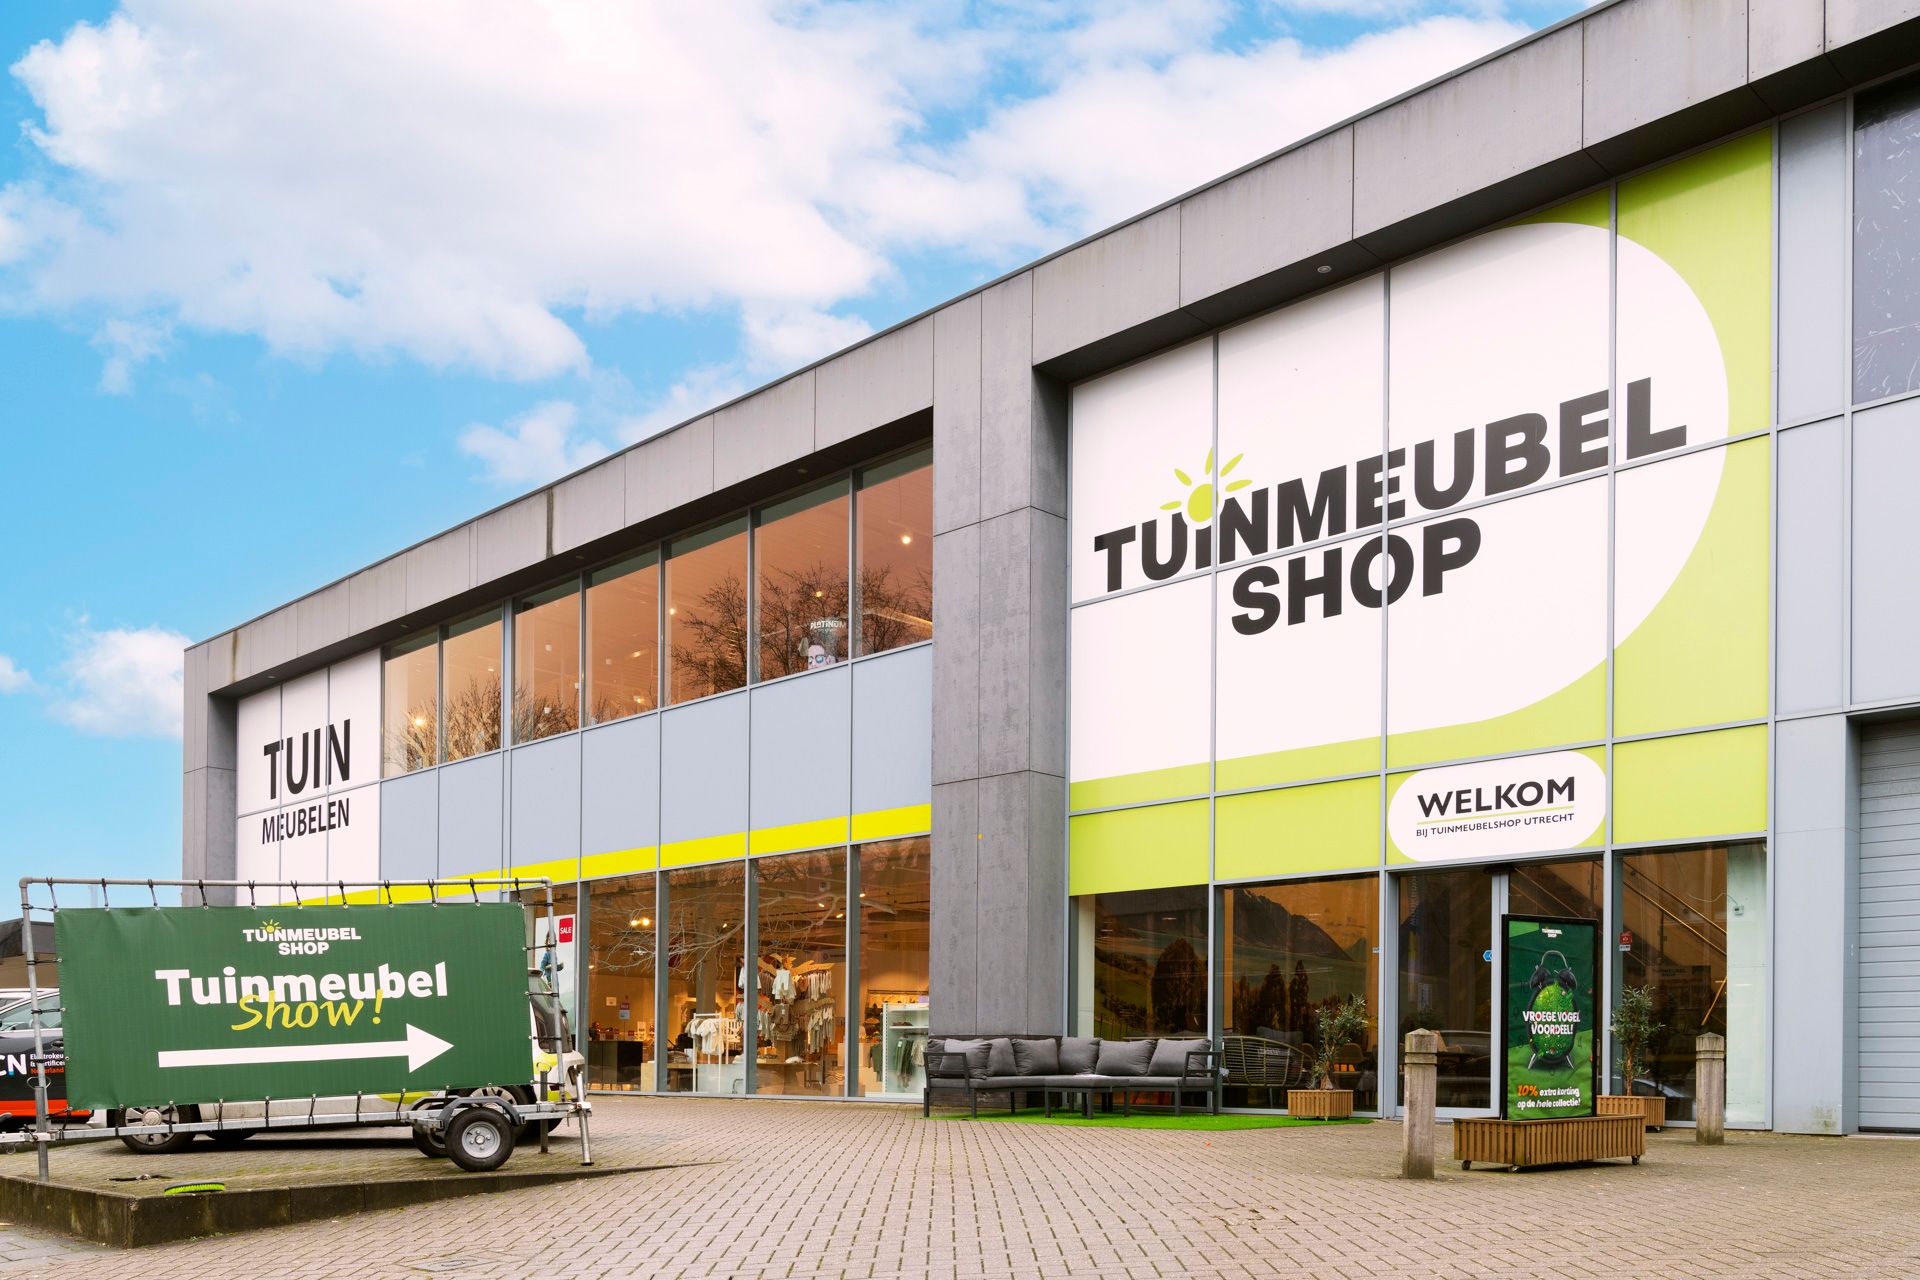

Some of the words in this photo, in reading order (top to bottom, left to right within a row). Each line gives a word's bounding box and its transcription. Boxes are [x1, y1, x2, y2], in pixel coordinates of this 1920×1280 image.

[1231, 516, 1482, 637] SHOP
[263, 719, 350, 800] TUIN
[1417, 776, 1575, 818] WELKOM
[262, 798, 349, 844] MEUBELEN
[1416, 828, 1429, 838] BIJ
[1431, 819, 1522, 836] TUINMEUBELSHOP
[1524, 813, 1575, 826] UTRECHT
[559, 926, 573, 935] SALE
[278, 941, 330, 956] SHOP
[154, 960, 449, 1006] Tuinmeubel
[1522, 1010, 1557, 1022] VROEGE
[1557, 1010, 1581, 1022] VOGEL
[1530, 1023, 1574, 1035] VOORDEEL!
[1517, 1084, 1538, 1097] 10%
[1539, 1088, 1557, 1097] extra
[1517, 1101, 1526, 1111] op
[1526, 1099, 1536, 1108] de
